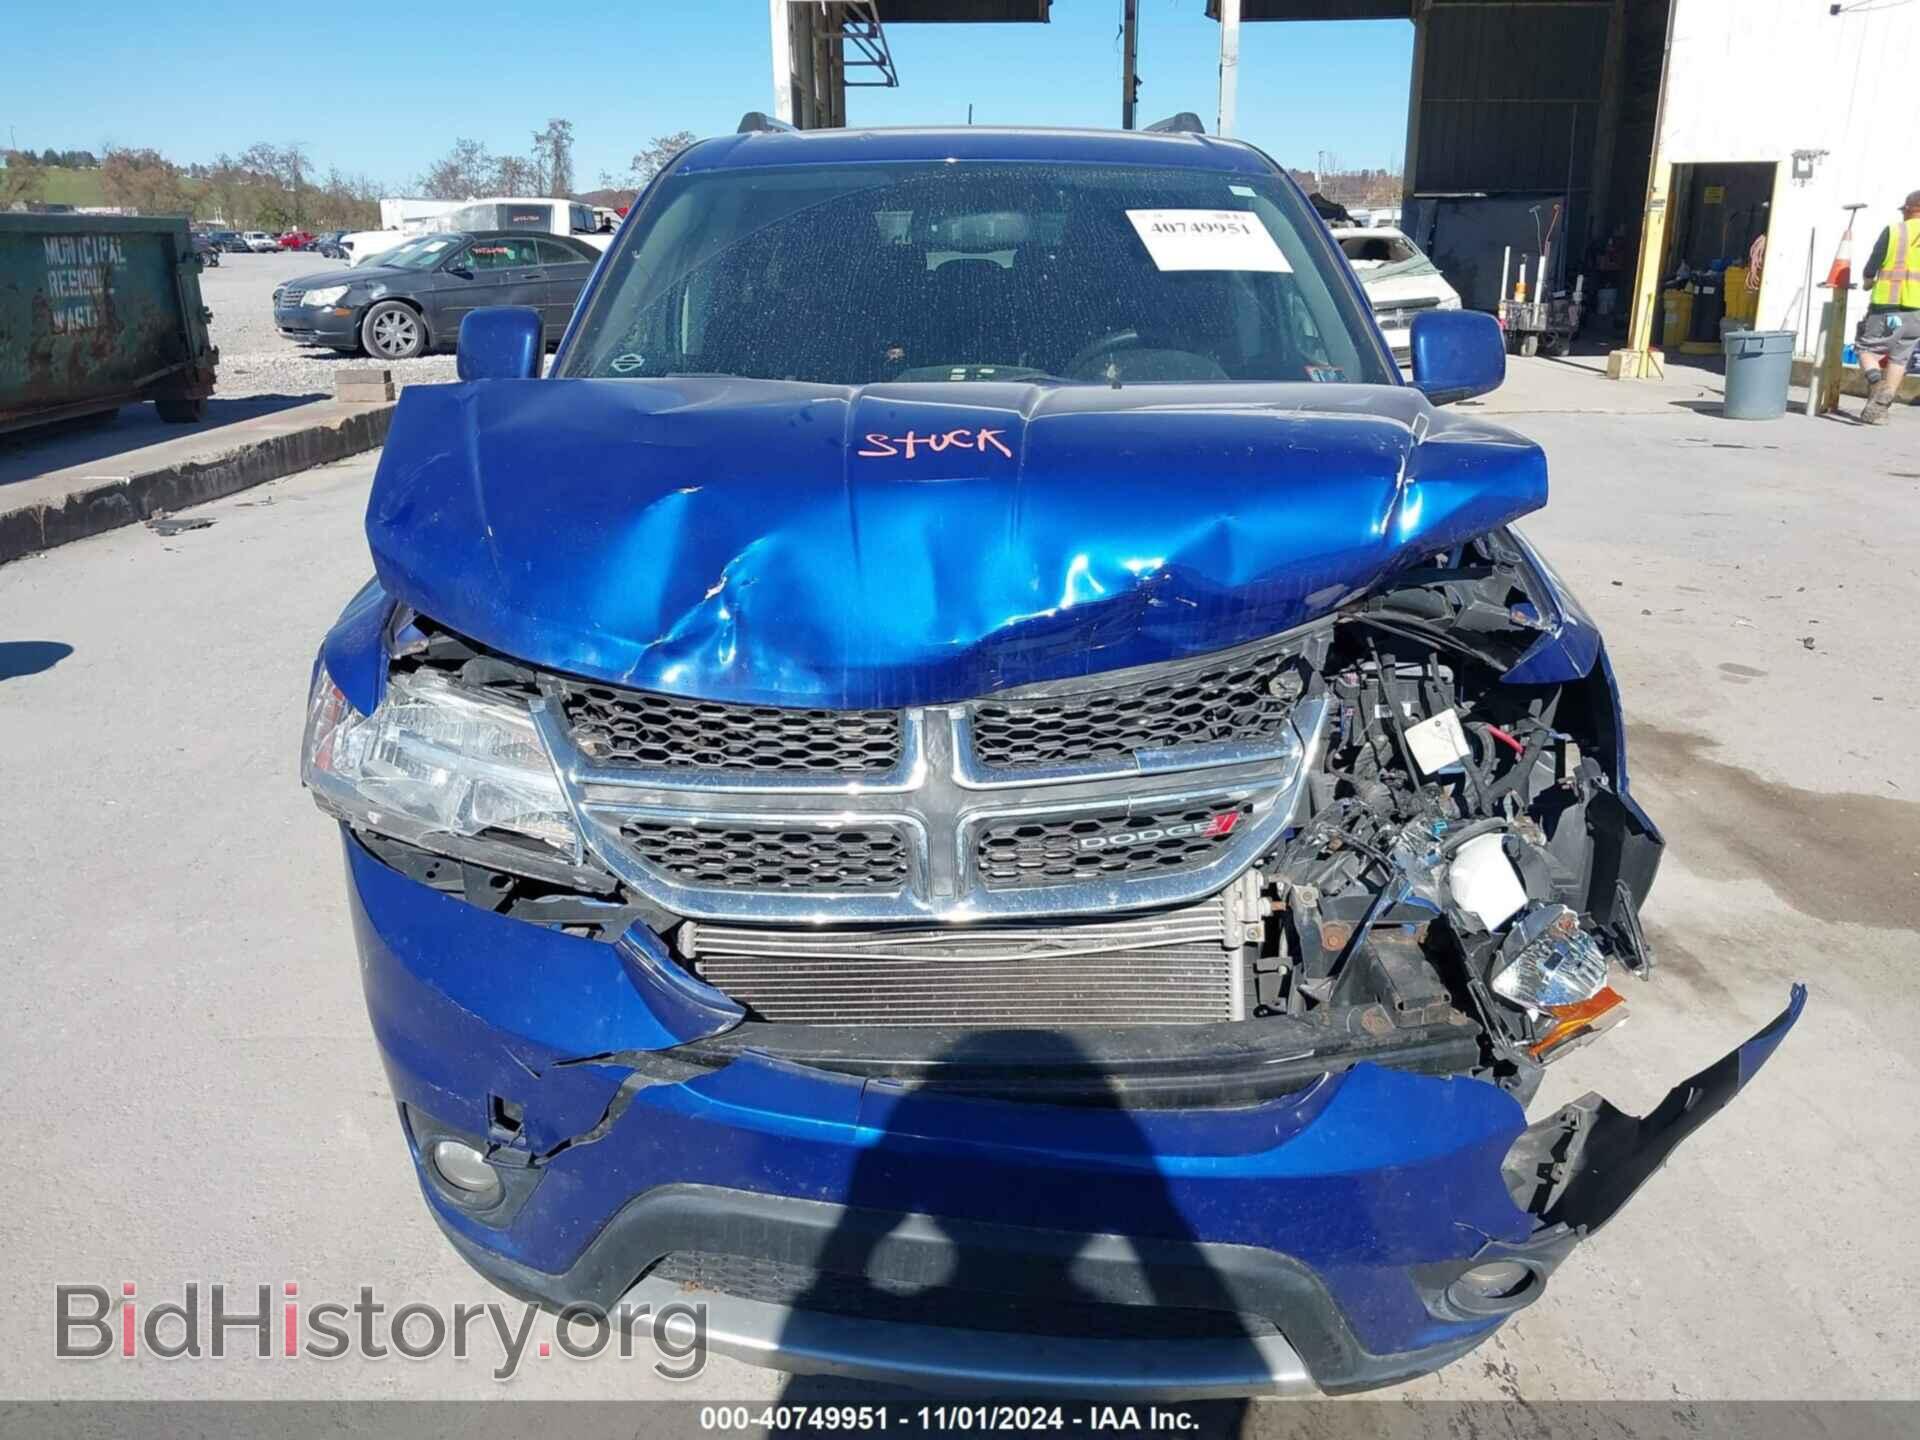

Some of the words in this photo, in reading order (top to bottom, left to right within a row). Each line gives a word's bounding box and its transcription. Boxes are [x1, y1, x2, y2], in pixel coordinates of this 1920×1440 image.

[1151, 222, 1251, 235] 40749951
[43, 235, 127, 264] MUNICIPAL
[48, 270, 114, 297] RESIDU
[52, 304, 99, 334] WAST
[1079, 821, 1216, 850] DODGE
